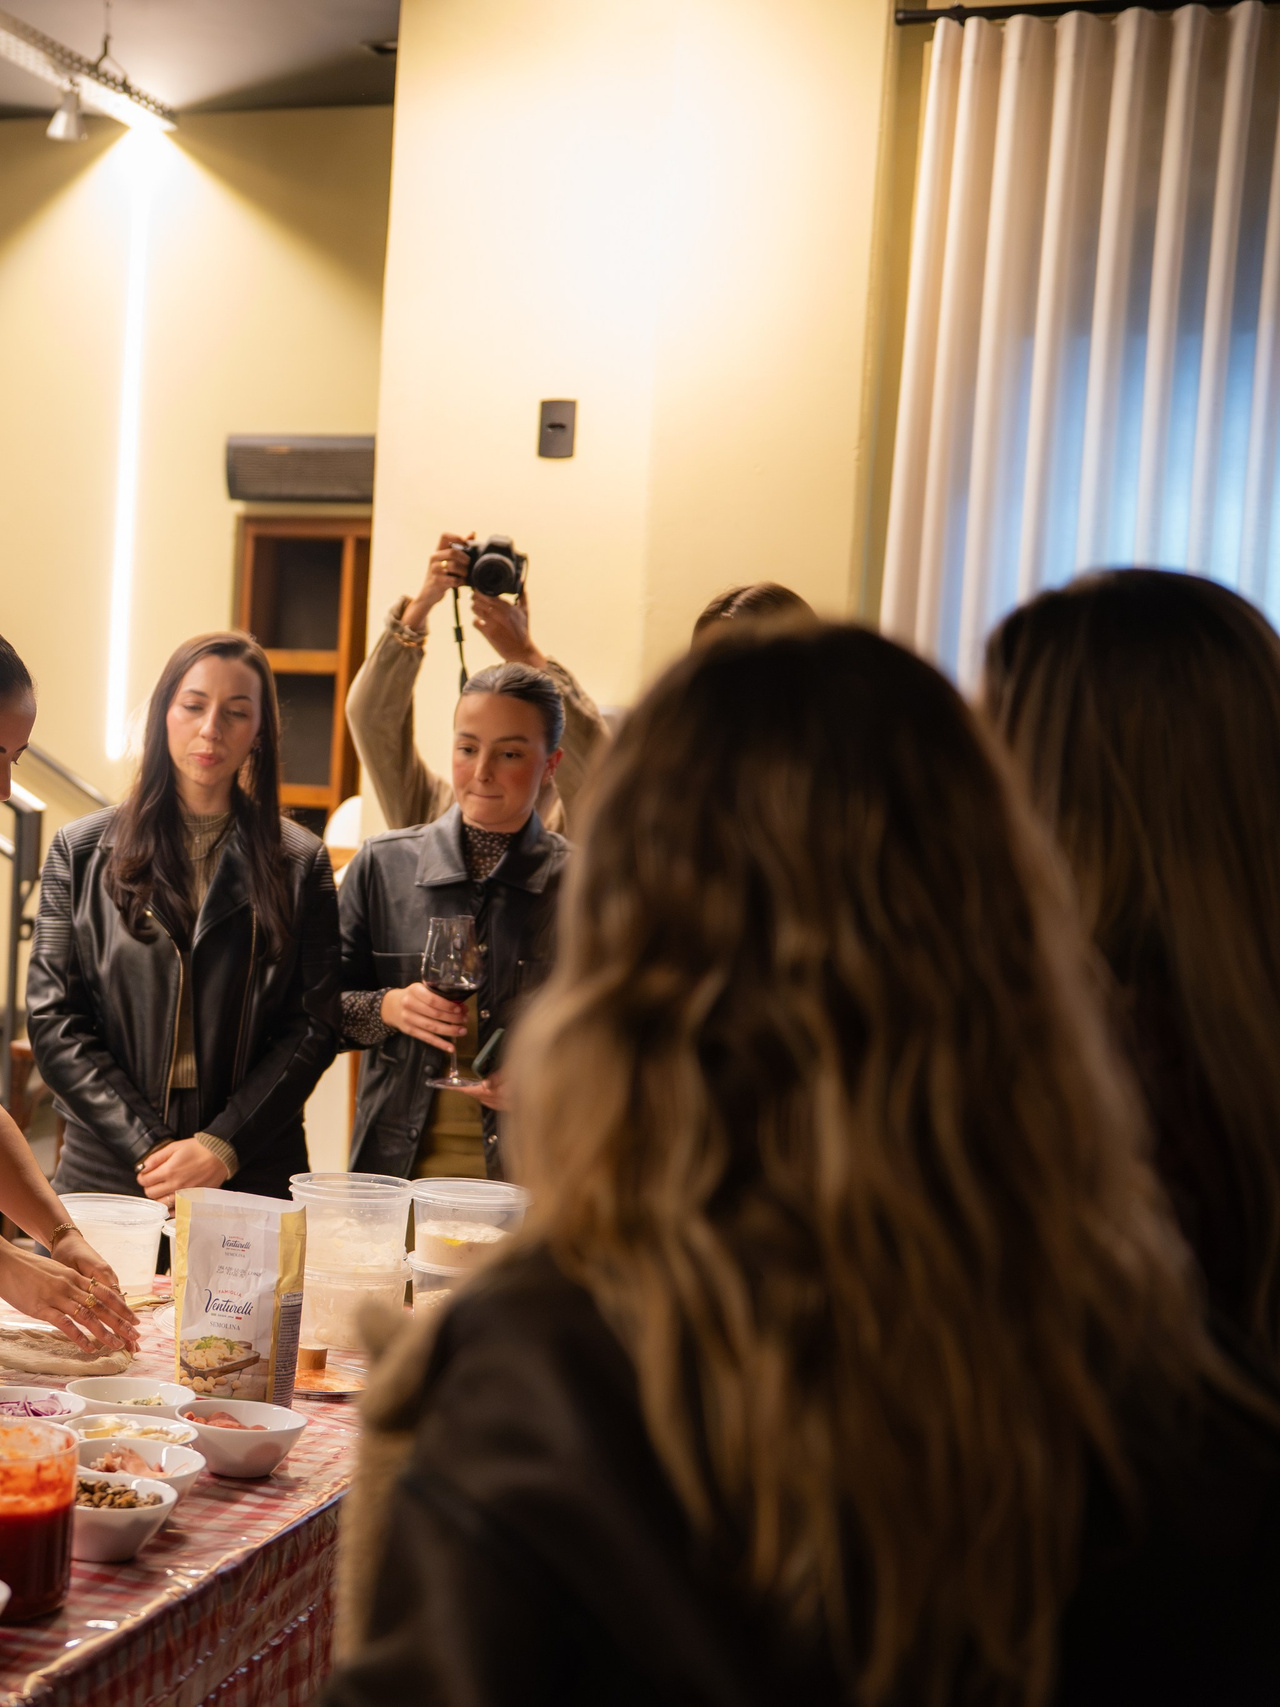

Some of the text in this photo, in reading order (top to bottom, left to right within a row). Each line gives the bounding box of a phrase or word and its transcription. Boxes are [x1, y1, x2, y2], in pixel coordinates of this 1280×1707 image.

[221, 1234, 252, 1250] Venturelli
[218, 1289, 242, 1298] FAMIGLIA
[204, 1288, 254, 1316] Venturelli
[209, 1321, 241, 1331] SEMOLINA
